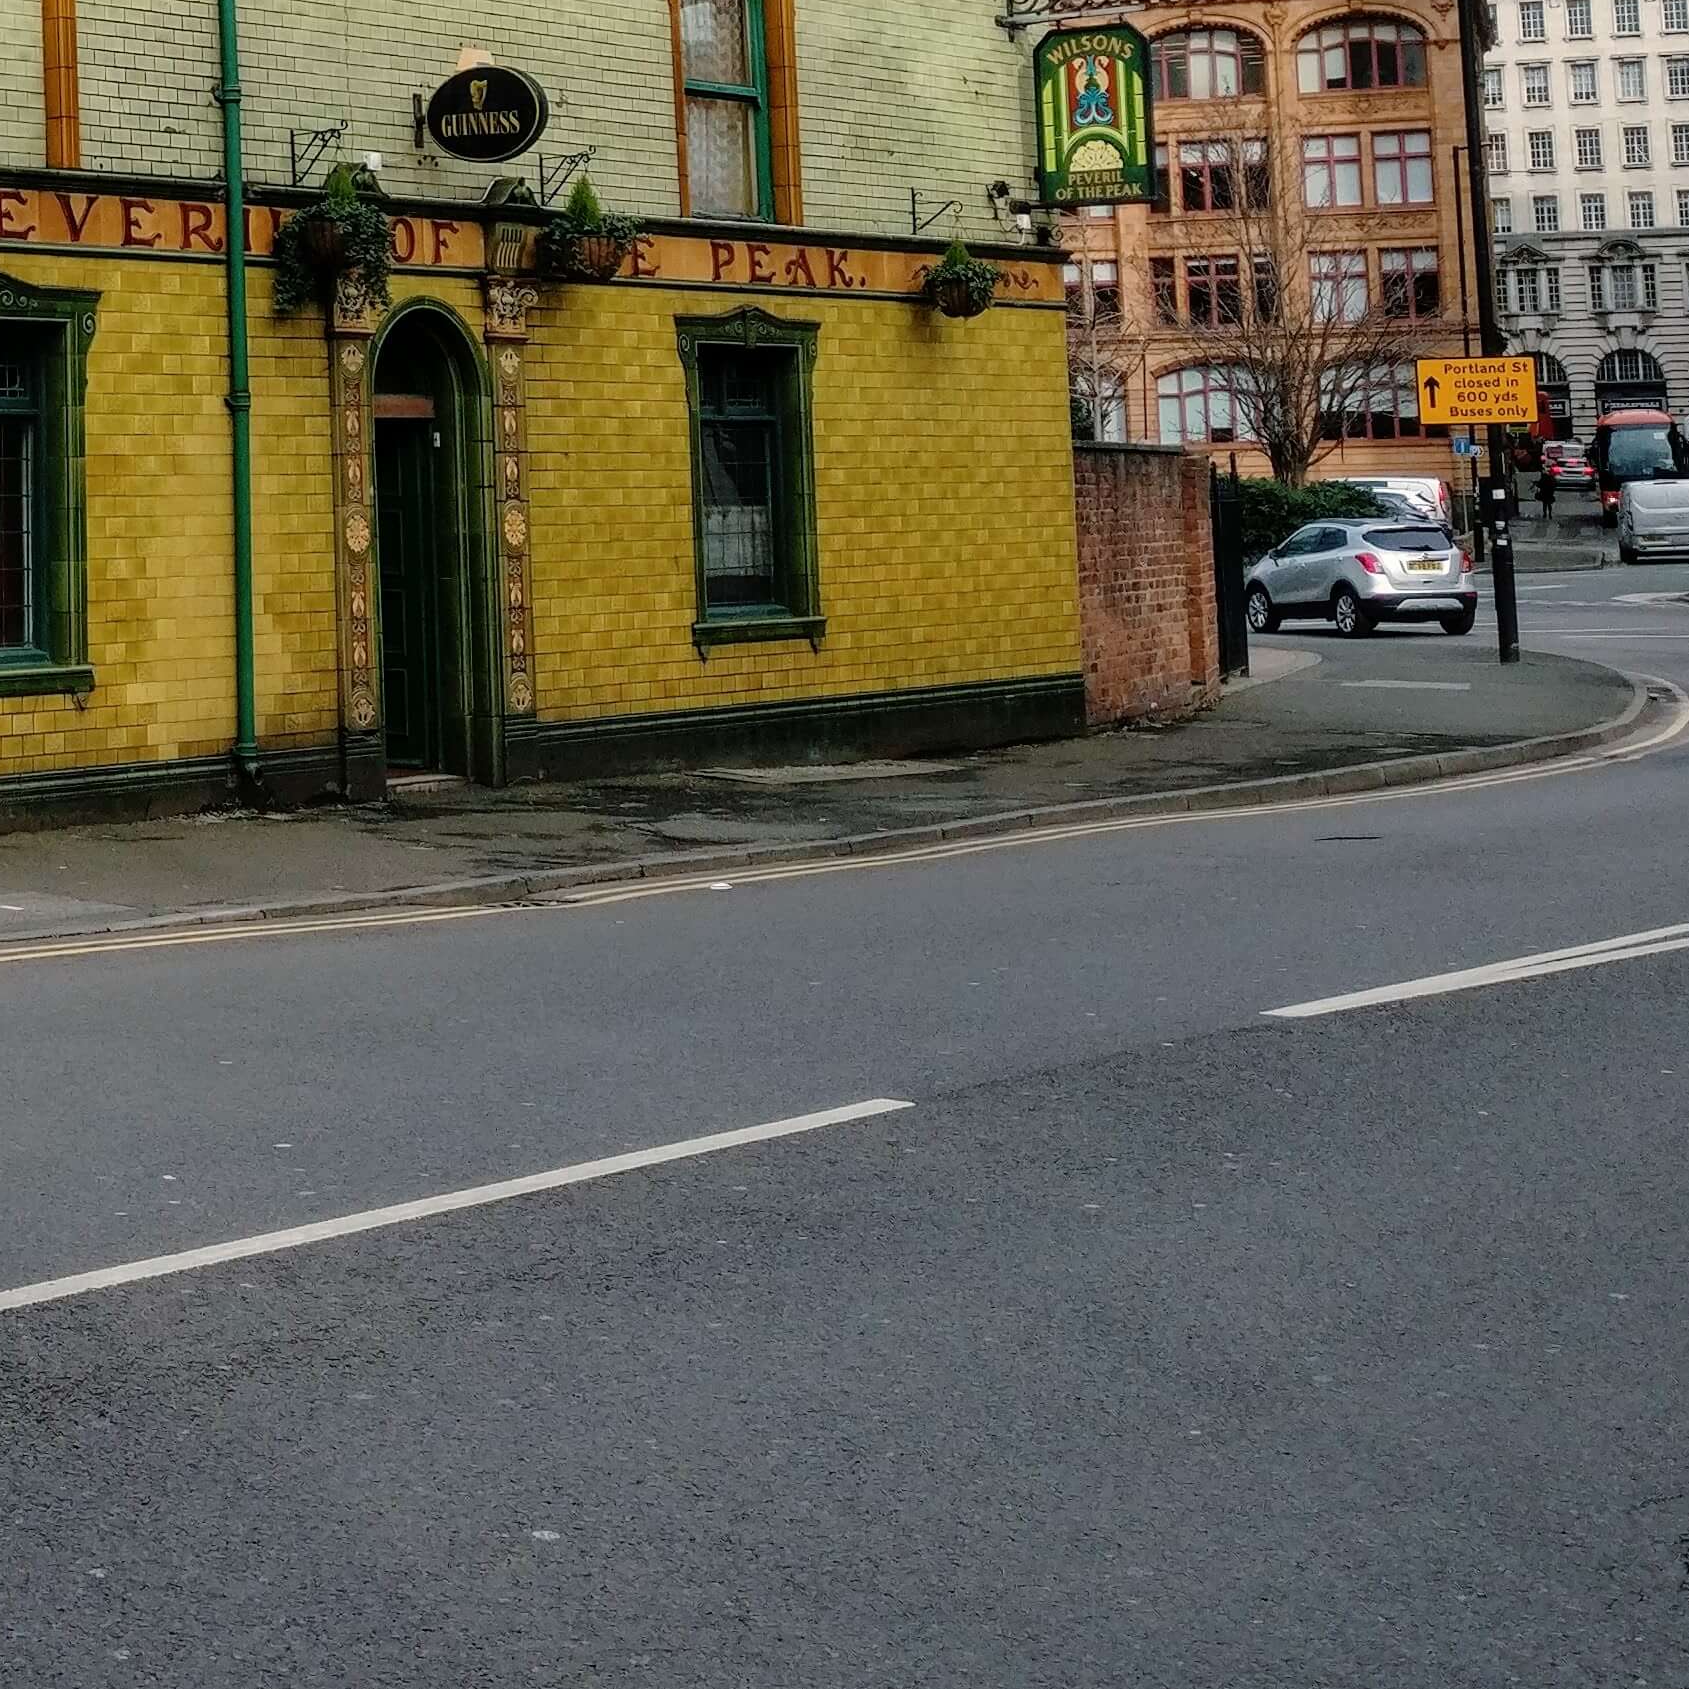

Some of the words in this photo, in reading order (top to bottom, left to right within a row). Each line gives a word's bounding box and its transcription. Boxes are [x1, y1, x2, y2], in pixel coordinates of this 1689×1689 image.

[1048, 35, 1134, 64] WILSONS
[441, 110, 521, 138] GUINNESS
[1069, 171, 1124, 185] PEVERIL
[1055, 189, 1073, 200] OF
[1077, 187, 1103, 199] THE
[1105, 183, 1143, 197] PEAK
[390, 217, 459, 265] OF
[1444, 362, 1506, 375] Portland
[1512, 361, 1529, 373] St
[1454, 377, 1500, 389] closed
[1506, 377, 1519, 387] in
[1457, 391, 1488, 403] 600
[1493, 391, 1518, 404] yds
[1450, 406, 1493, 417] Buses
[1497, 404, 1529, 418] only
